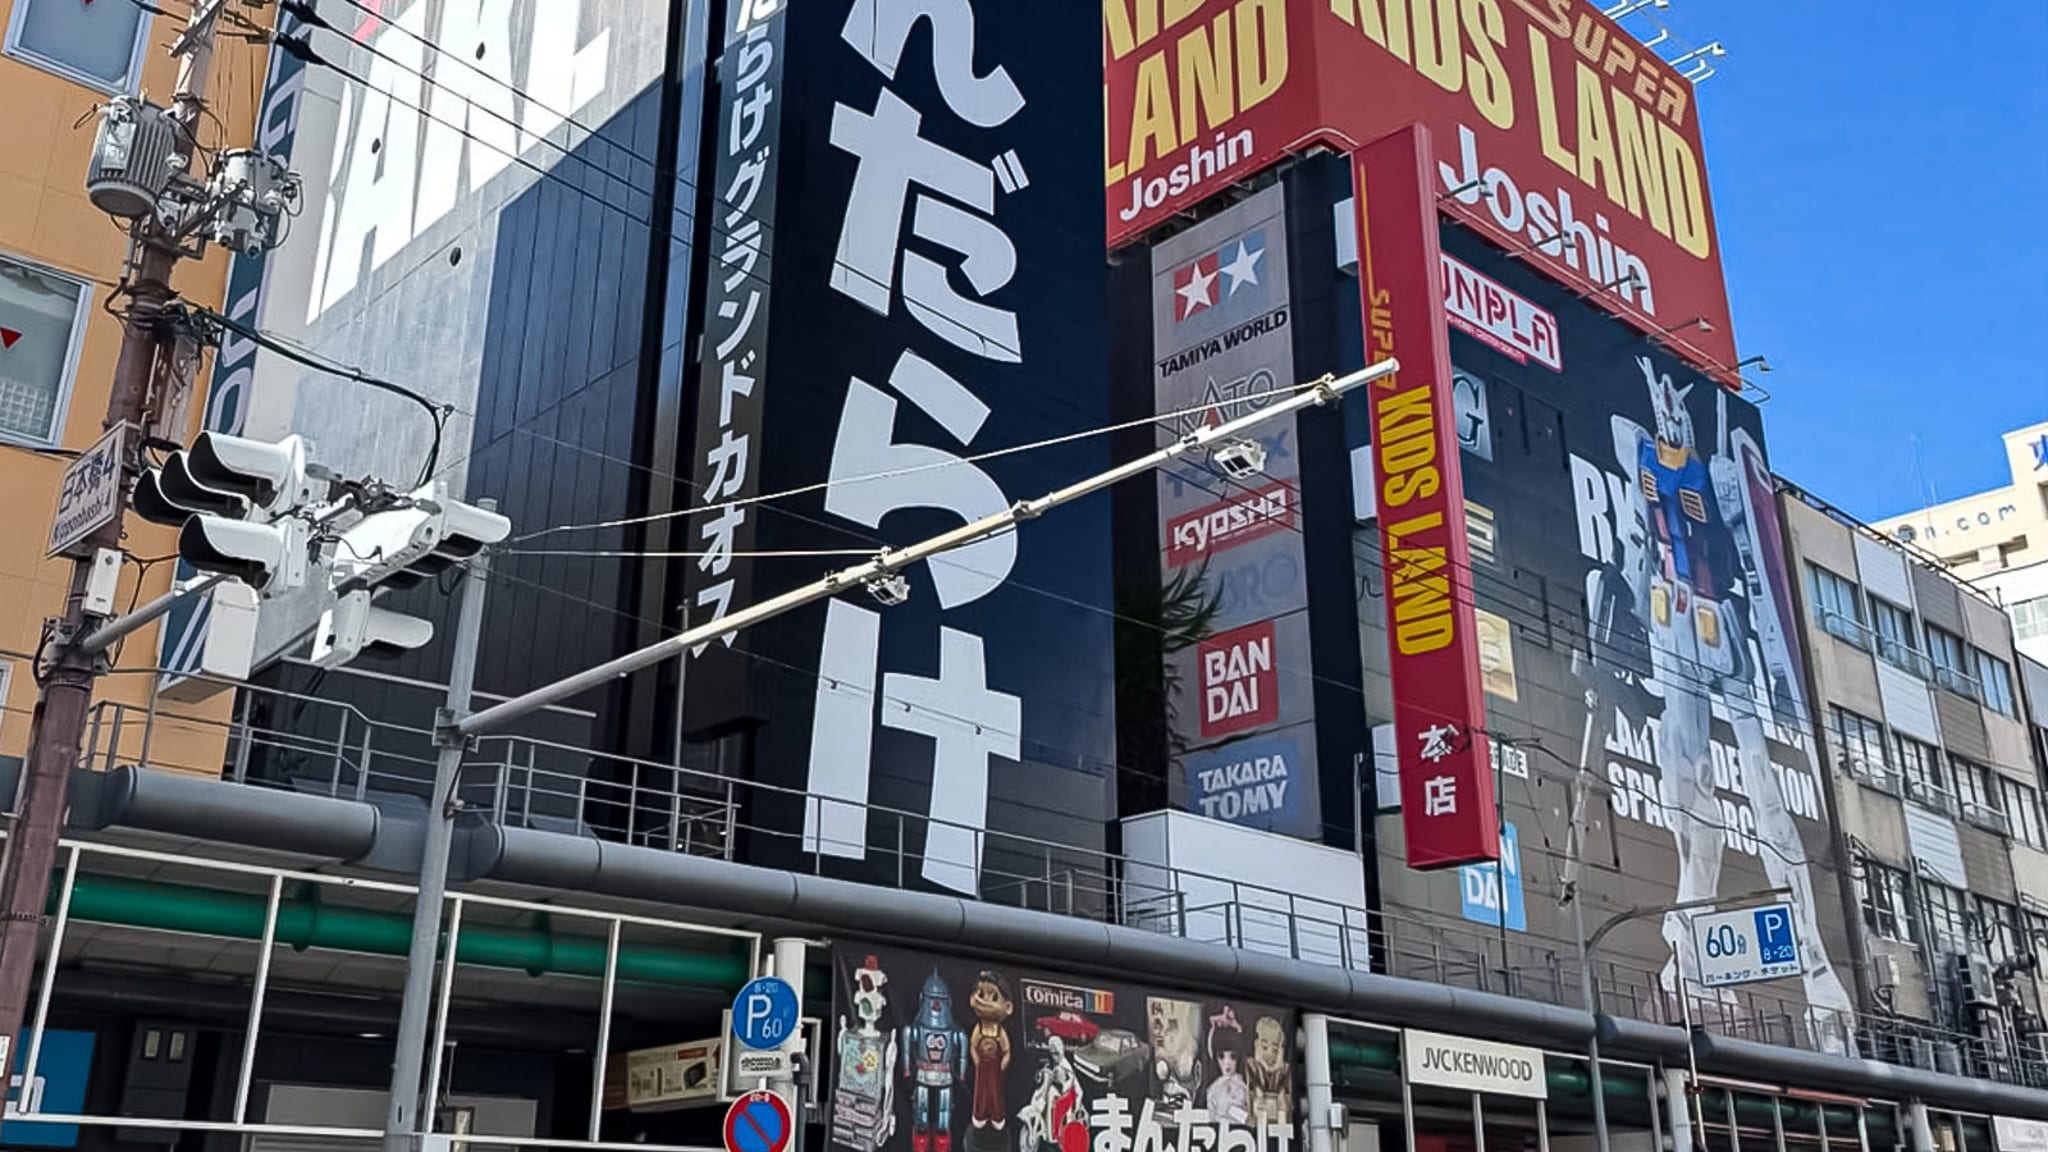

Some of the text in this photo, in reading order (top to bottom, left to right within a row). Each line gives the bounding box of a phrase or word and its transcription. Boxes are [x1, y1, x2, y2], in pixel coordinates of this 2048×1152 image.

[1119, 128, 1254, 222] Joshin
[1527, 24, 1711, 260] LAND
[1438, 123, 1656, 317] Joshin
[1159, 309, 1289, 379] TAMIYA WORLD
[1175, 367, 1277, 441] KATO
[1377, 385, 1441, 508] KIDS
[1387, 510, 1455, 656] LAND
[1204, 636, 1272, 687] BAN
[1205, 676, 1259, 724] DAI
[1198, 754, 1289, 793] TAKARA
[1199, 779, 1288, 820] TOMY
[1417, 722, 1460, 817] 本店
[1764, 913, 1783, 943] P
[747, 994, 782, 1039] P 60
[1421, 1046, 1533, 1082] JVCKENWOOD
